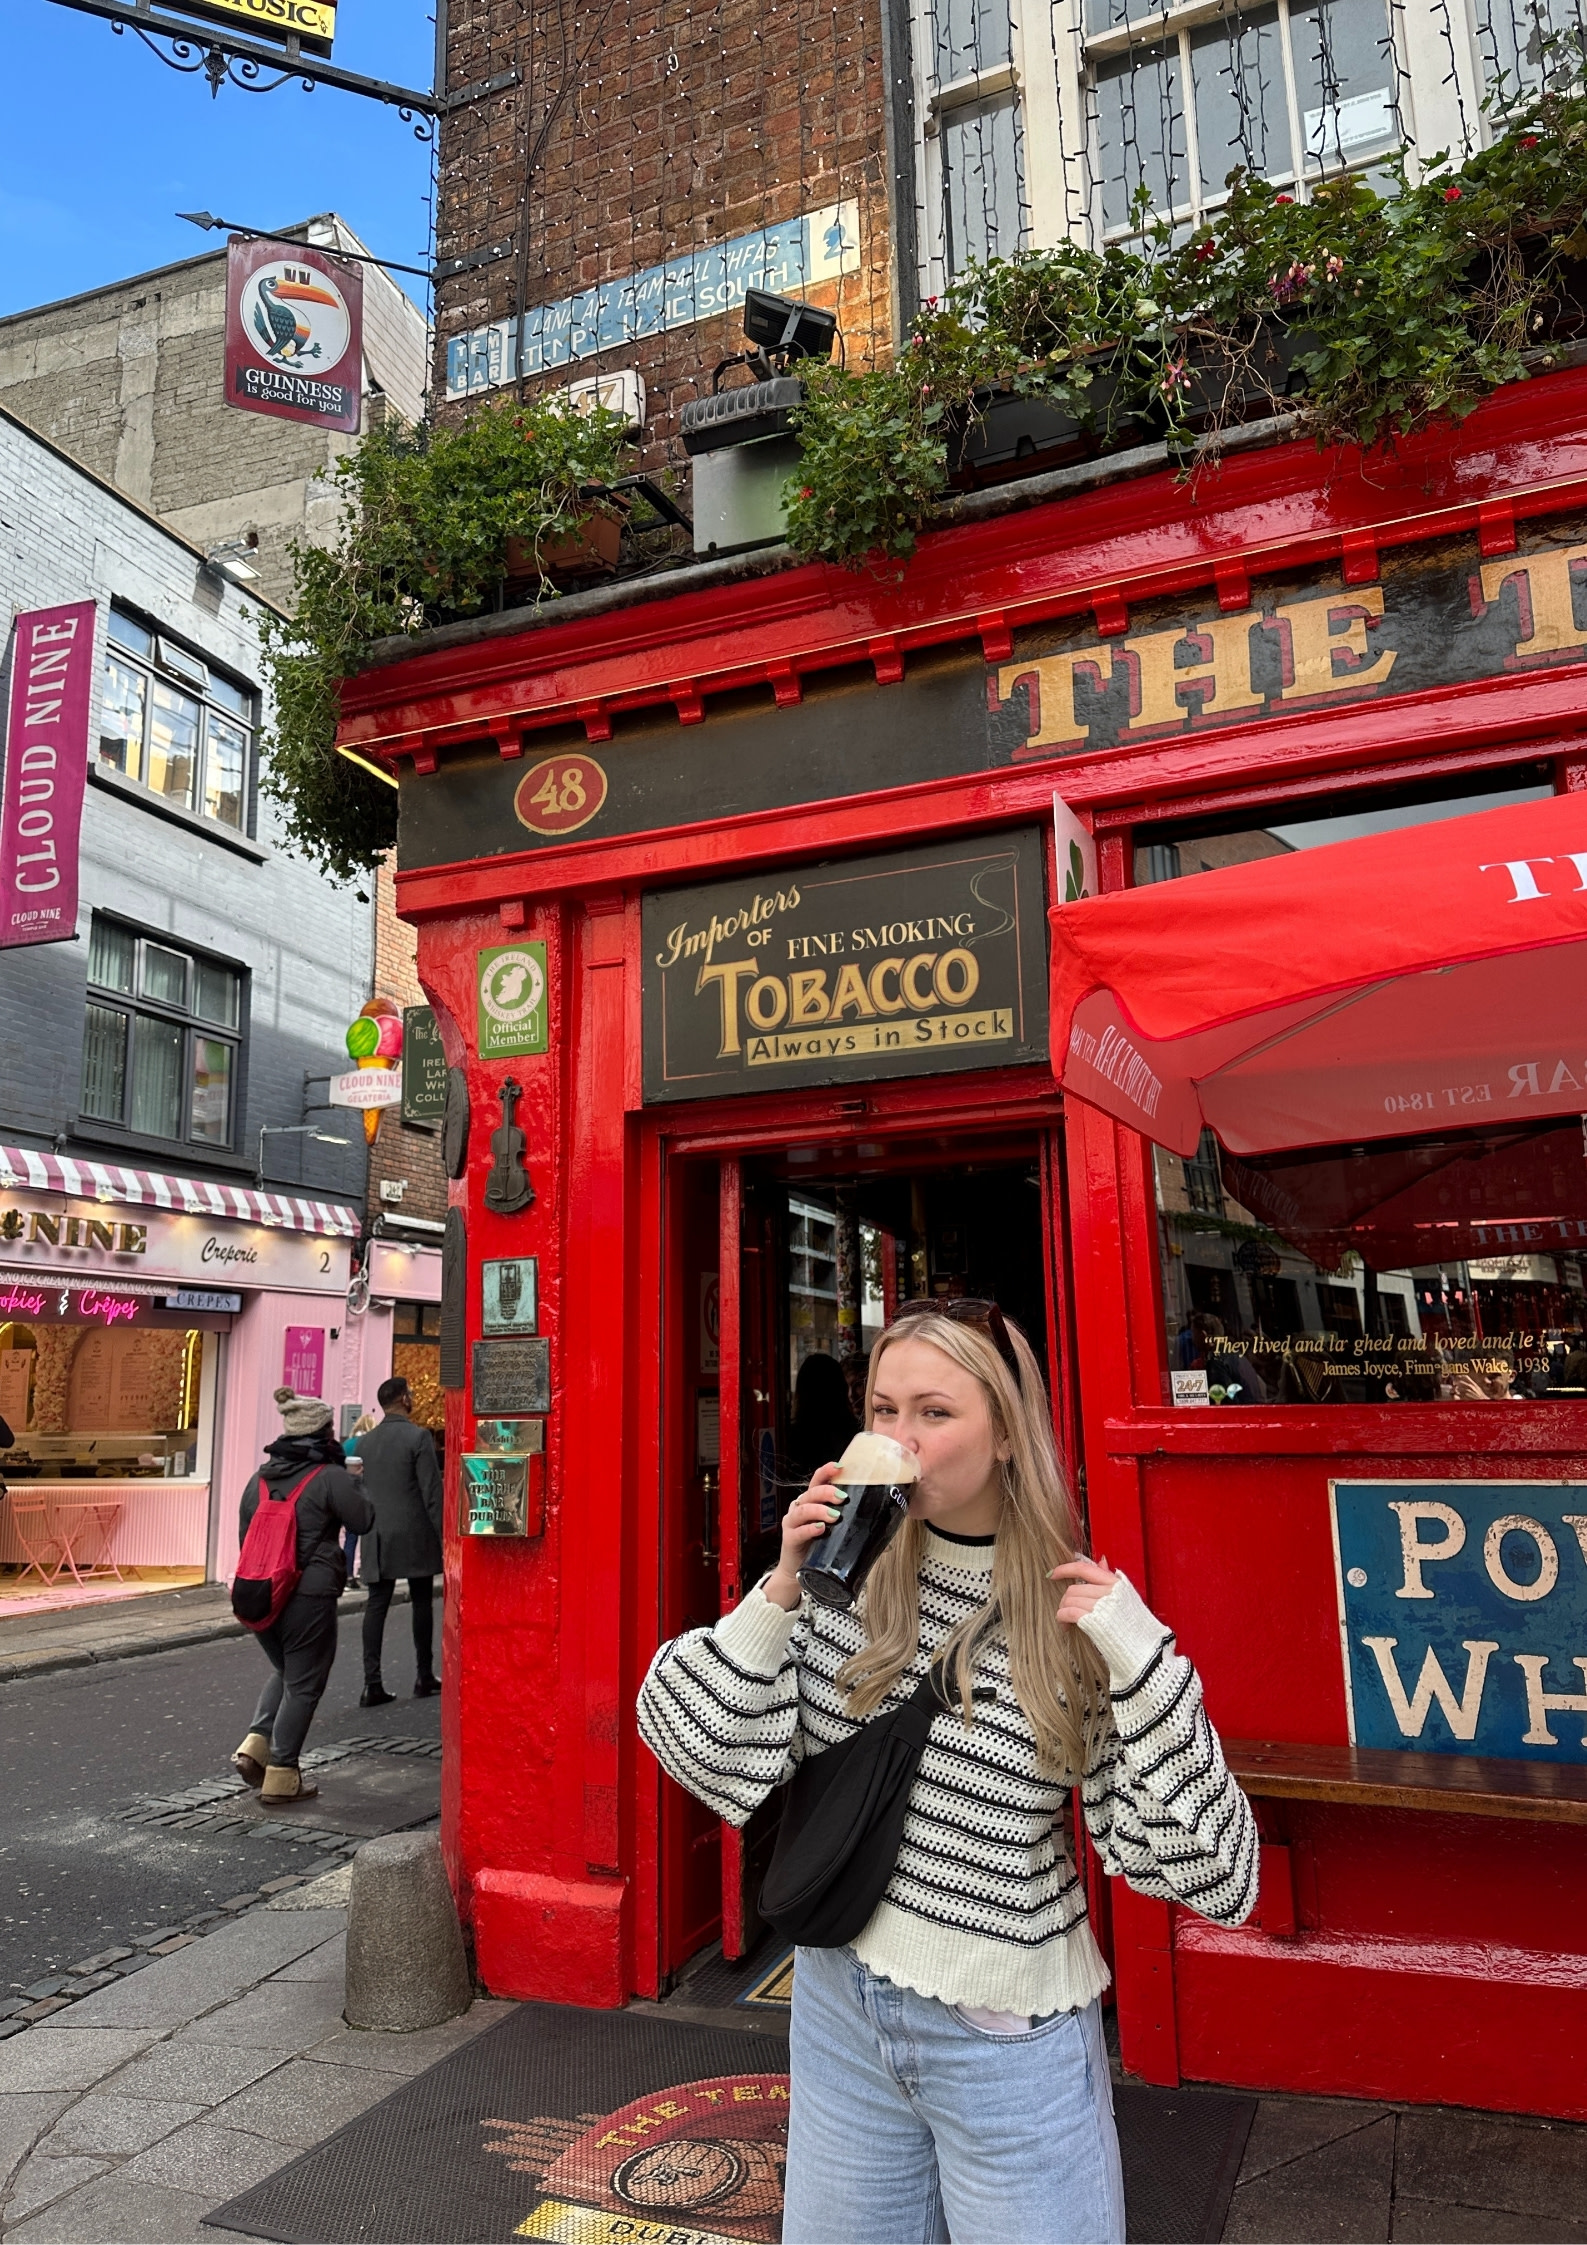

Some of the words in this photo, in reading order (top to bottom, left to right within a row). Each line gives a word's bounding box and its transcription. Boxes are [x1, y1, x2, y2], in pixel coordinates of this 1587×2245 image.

[220, 0, 318, 27] USIC
[823, 224, 848, 262] 2
[699, 260, 789, 310] SOUTH
[245, 368, 342, 402] GUINNESS
[457, 365, 500, 389] BAR
[247, 382, 258, 394] is
[260, 386, 293, 401] good
[297, 393, 316, 406] for
[319, 400, 342, 412] you
[24, 617, 79, 728] NINE
[990, 588, 1398, 760] THE
[529, 768, 587, 816] 48
[15, 744, 61, 894] CLOUD
[11, 910, 39, 926] CLOUD
[40, 907, 61, 920] NINE
[655, 883, 802, 969] Importers
[746, 928, 773, 948] OF
[786, 931, 846, 961] FINE
[850, 912, 977, 952] SMOKING
[486, 963, 499, 977] THE
[501, 953, 537, 973] IRELAND
[486, 999, 516, 1019] WHISKEY
[518, 997, 537, 1017] TRAIL
[694, 947, 981, 1060] TOBACCO
[412, 1026, 429, 1040] The
[490, 1032, 536, 1047] Member
[492, 1019, 532, 1035] Official
[751, 1032, 857, 1062] Always
[873, 1027, 901, 1047] in
[914, 1011, 1008, 1042] Stock
[339, 1075, 373, 1091] CLOUD
[376, 1074, 402, 1089] NINE
[347, 1095, 392, 1104] GELATERIA
[26, 1211, 148, 1254] NINE
[1470, 1223, 1543, 1245] THE
[201, 1236, 258, 1266] Creperie
[319, 1251, 332, 1274] 2
[59, 1288, 69, 1316] &
[80, 1289, 140, 1326] Crêpes
[1204, 1335, 1249, 1358] “They
[1252, 1334, 1291, 1354] lived
[1294, 1334, 1325, 1353] and
[1397, 1332, 1428, 1351] and
[1433, 1331, 1478, 1351] loved
[1481, 1331, 1515, 1350] and
[291, 1352, 318, 1369] CLOUD
[1322, 1360, 1361, 1376] James
[1363, 1360, 1403, 1379] Joyce,
[1470, 1358, 1513, 1375] Wake,
[1516, 1357, 1551, 1374] 1938
[291, 1369, 317, 1391] NINE
[482, 1469, 506, 1481] THE
[469, 1510, 515, 1522] DUBLIN
[481, 1497, 505, 1509] BAR
[594, 2101, 692, 2150] THE
